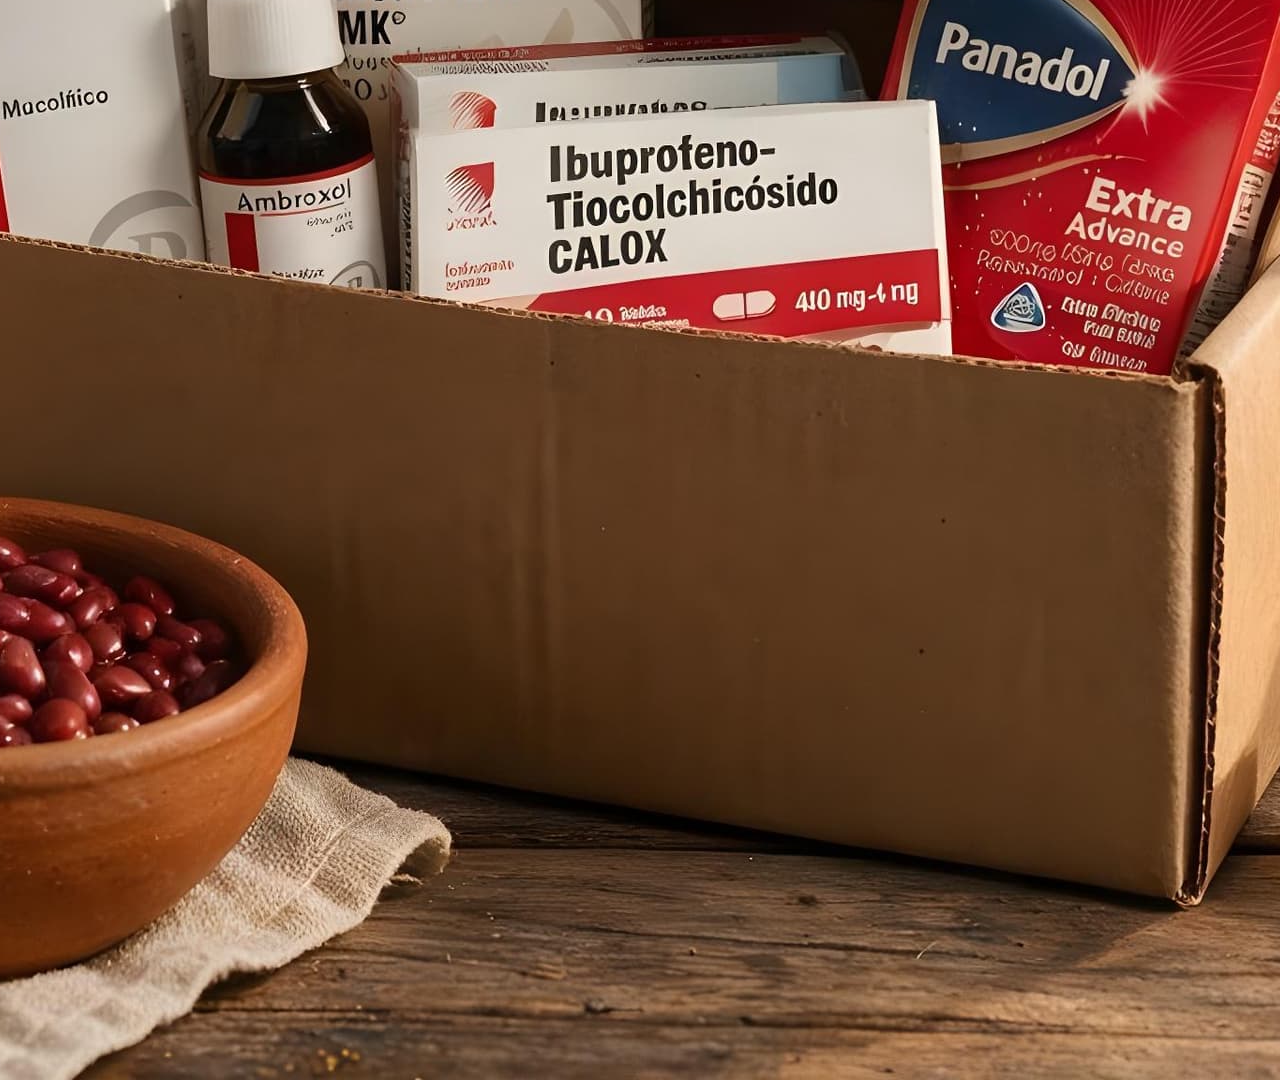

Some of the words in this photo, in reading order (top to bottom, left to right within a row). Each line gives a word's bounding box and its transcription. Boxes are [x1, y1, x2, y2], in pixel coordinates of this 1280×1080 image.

[935, 20, 1111, 101] Panadol
[549, 134, 776, 186] Ibuprofeno-
[237, 177, 352, 212] Ambroxol
[546, 172, 838, 231] Tiocolchicósido
[1085, 175, 1193, 232] Extra
[548, 228, 668, 275] CALOX
[1064, 211, 1185, 259] Advance
